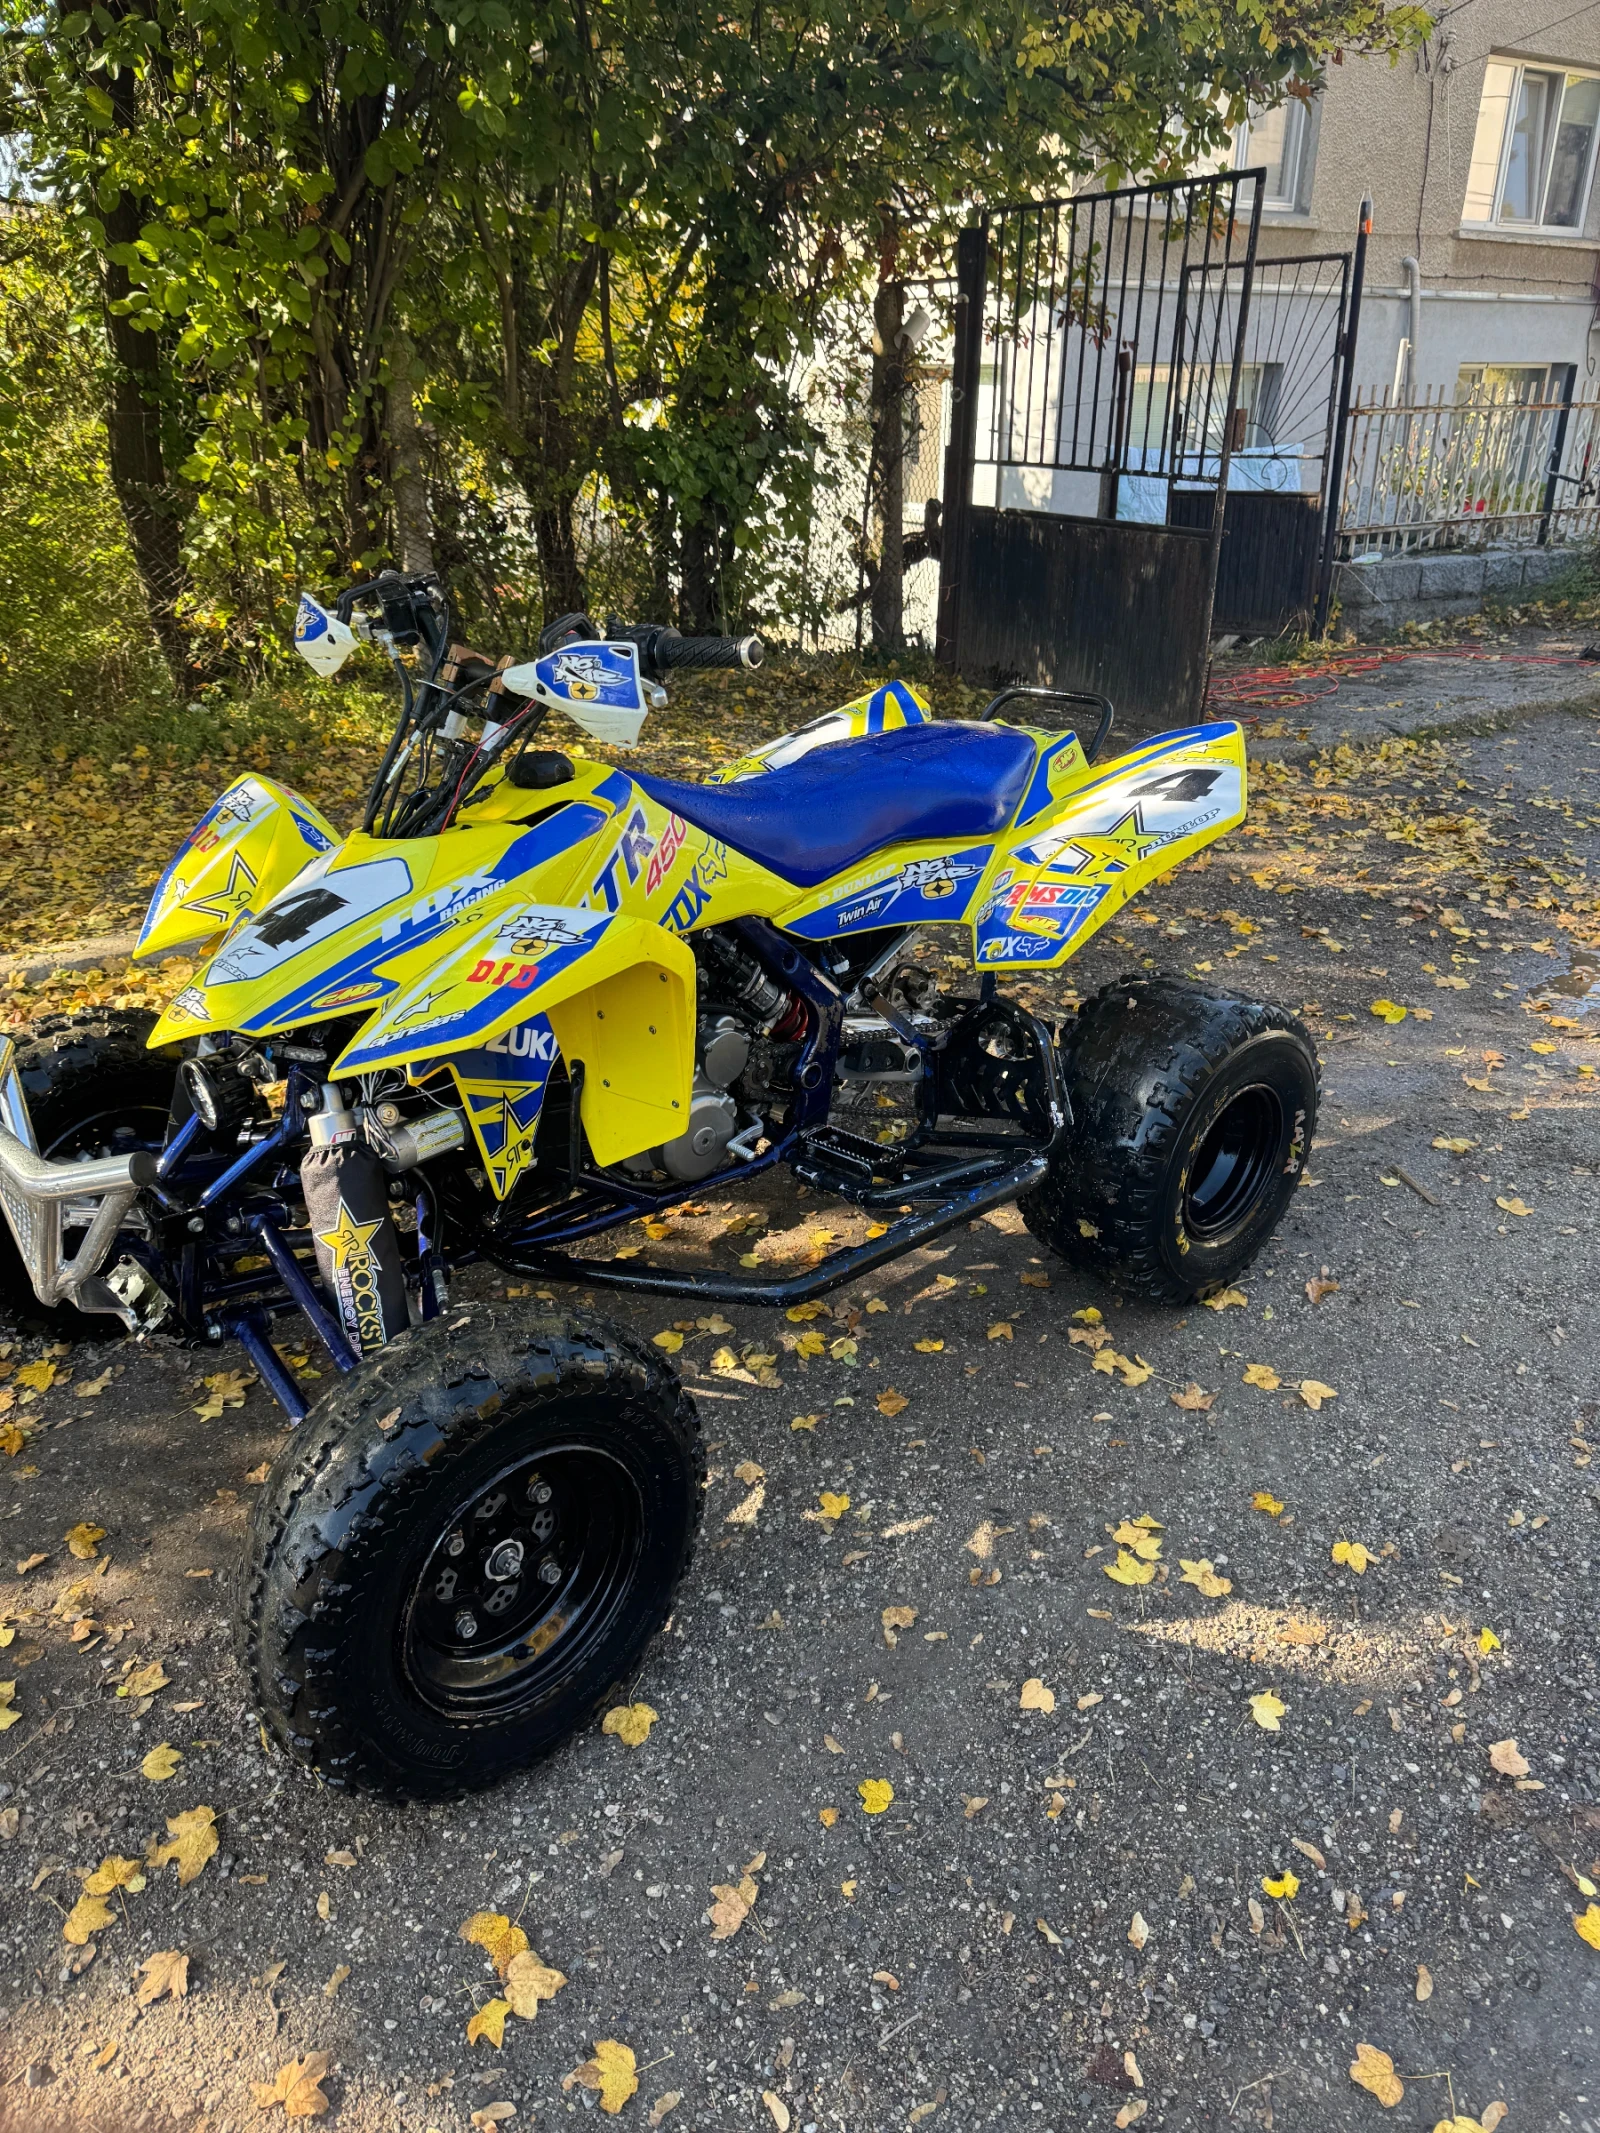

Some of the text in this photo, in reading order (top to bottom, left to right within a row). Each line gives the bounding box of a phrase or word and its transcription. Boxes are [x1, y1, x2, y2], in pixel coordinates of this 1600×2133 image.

[552, 665, 632, 686] FEAR
[558, 653, 600, 669] NO
[231, 789, 255, 806] NO
[1122, 769, 1226, 803] 4
[1149, 808, 1221, 850] DUNLOP
[576, 803, 687, 914] TR 450
[904, 856, 945, 876] NO
[832, 863, 898, 901] DUNLOP
[899, 866, 984, 891] FEAR
[380, 862, 498, 944] FOX
[440, 878, 506, 922] RACING
[838, 906, 865, 925] Twin
[866, 897, 883, 914] Air
[250, 888, 352, 951] 4
[494, 924, 592, 945] FEAR
[515, 915, 566, 930] NO
[171, 997, 212, 1021] FEAR
[179, 986, 206, 1002] NO
[472, 1026, 561, 1061] ZUKI
[338, 1268, 359, 1329] ENERGY
[348, 1253, 385, 1352] ROCKST
